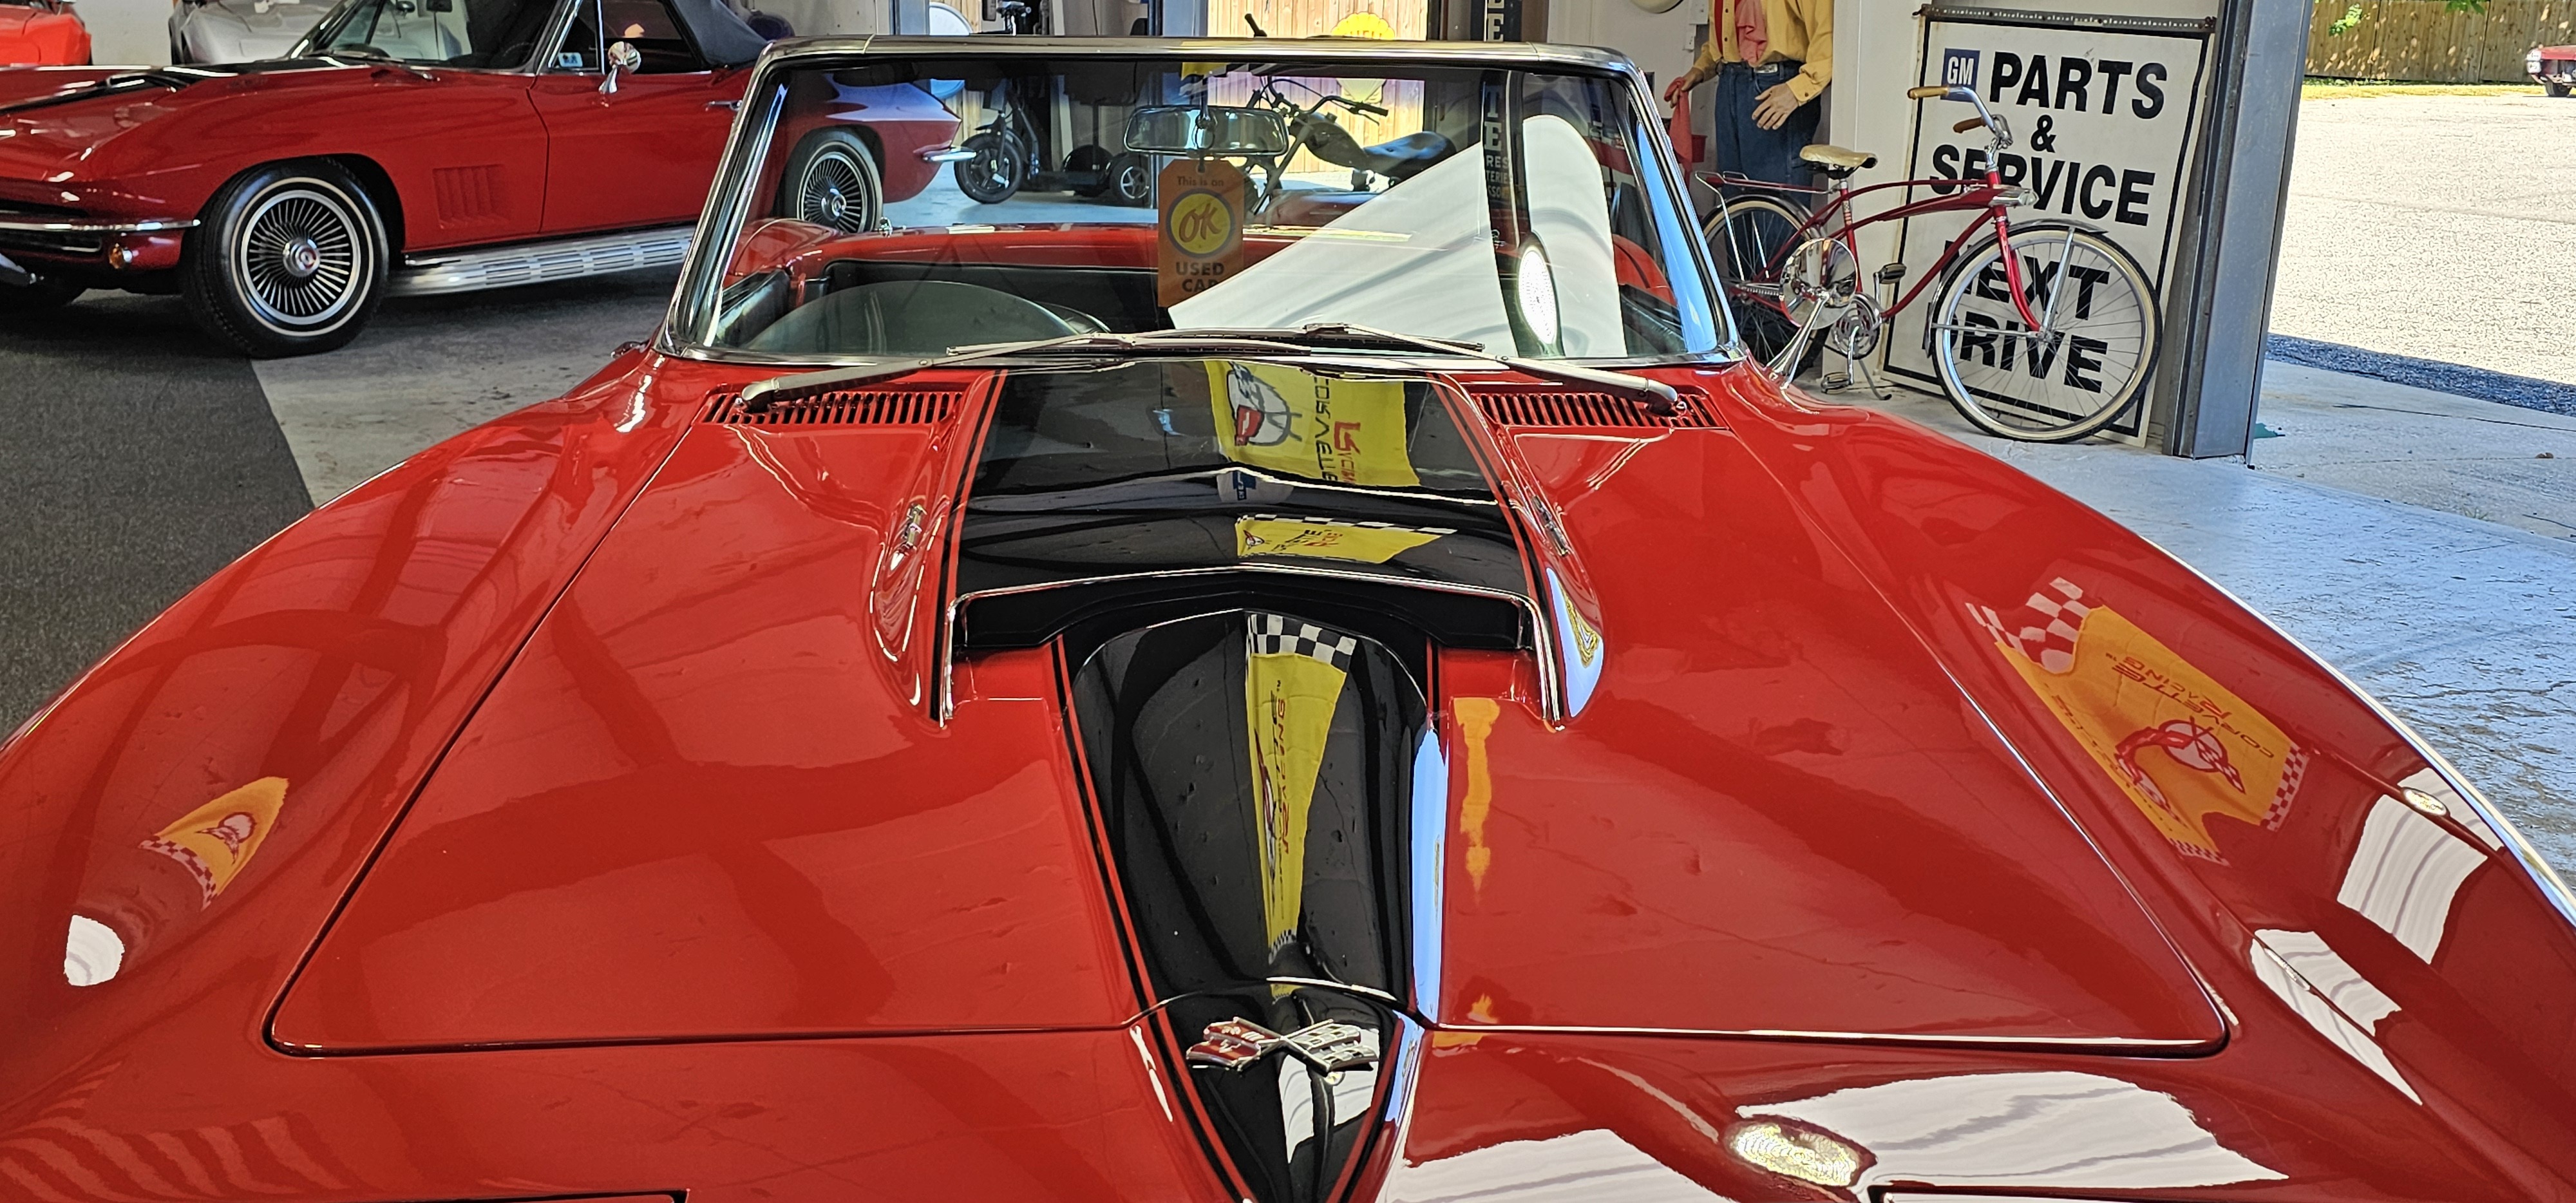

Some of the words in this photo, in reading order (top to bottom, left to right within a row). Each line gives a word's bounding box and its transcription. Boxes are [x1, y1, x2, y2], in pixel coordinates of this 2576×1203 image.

[1947, 56, 1975, 86] GM
[1989, 52, 2167, 120] PARTS
[2031, 115, 2056, 153] &
[1177, 176, 1197, 186] This
[1200, 177, 1208, 186] is
[1179, 203, 1222, 243] OK
[1176, 261, 1225, 276] USED
